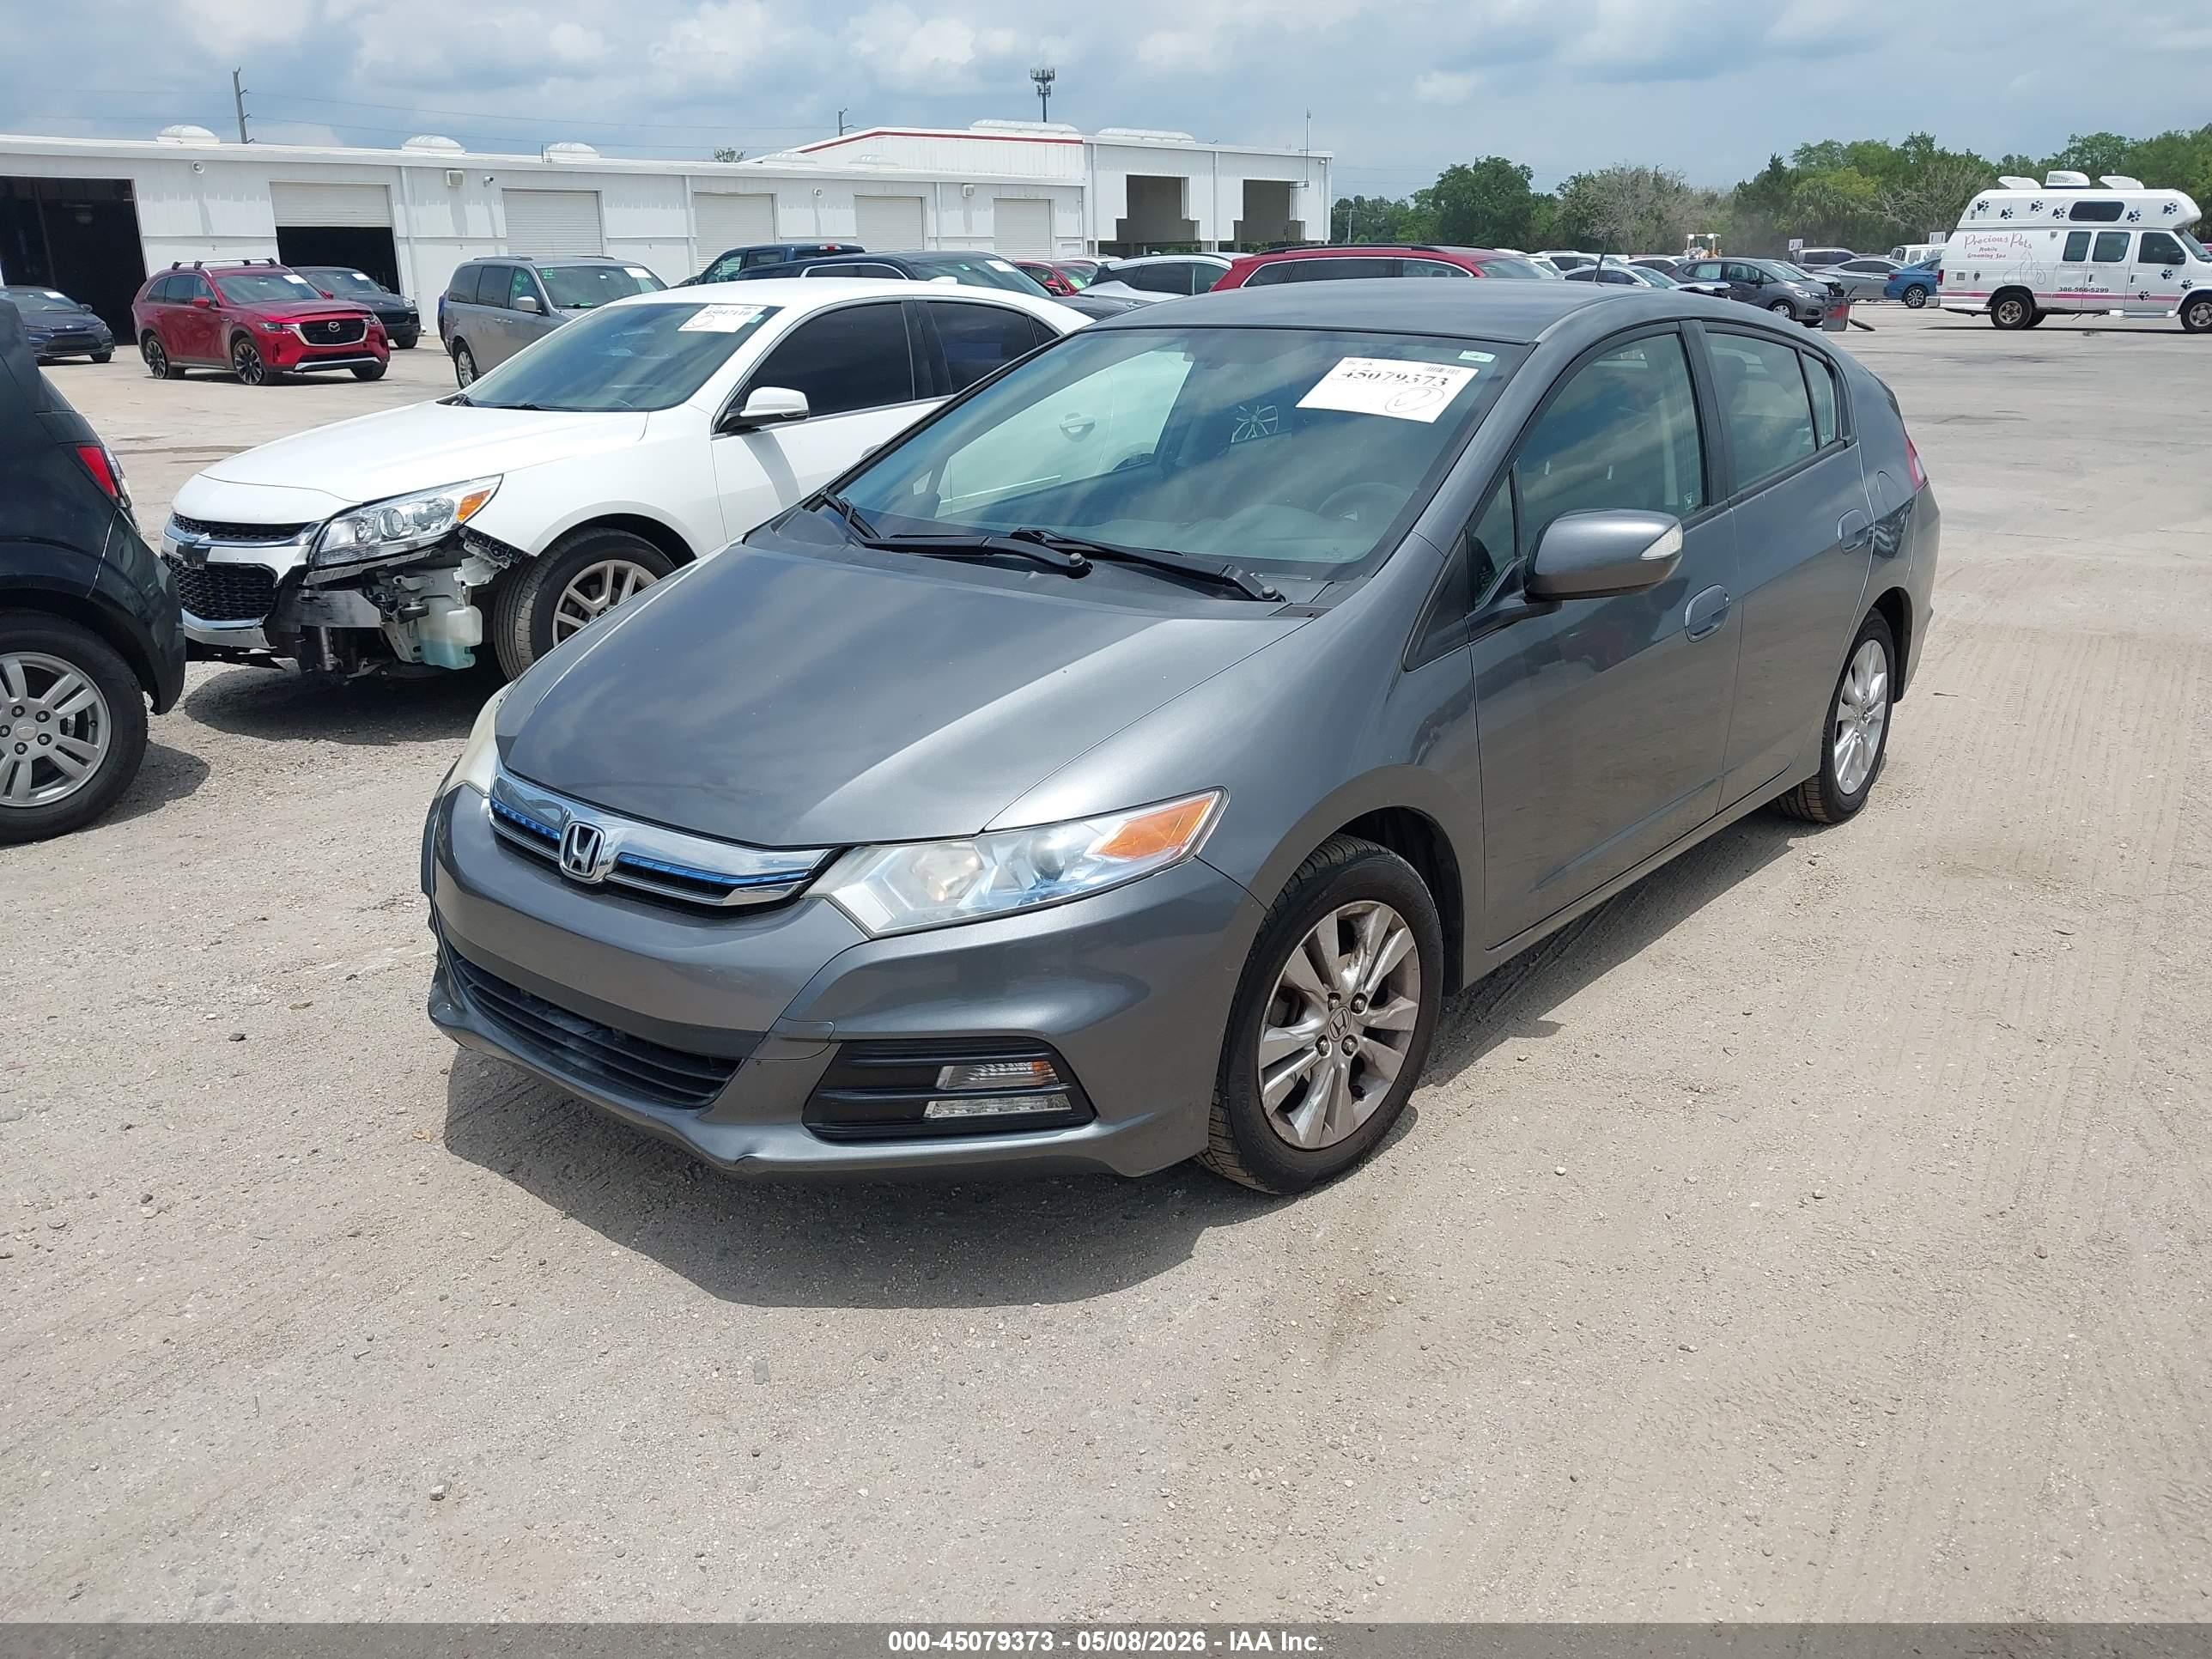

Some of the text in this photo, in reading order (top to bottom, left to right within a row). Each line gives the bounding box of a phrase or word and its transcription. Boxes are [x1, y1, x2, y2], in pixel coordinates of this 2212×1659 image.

[1965, 232, 2033, 249] Precious Pets
[1340, 368, 1449, 387] 45079373
